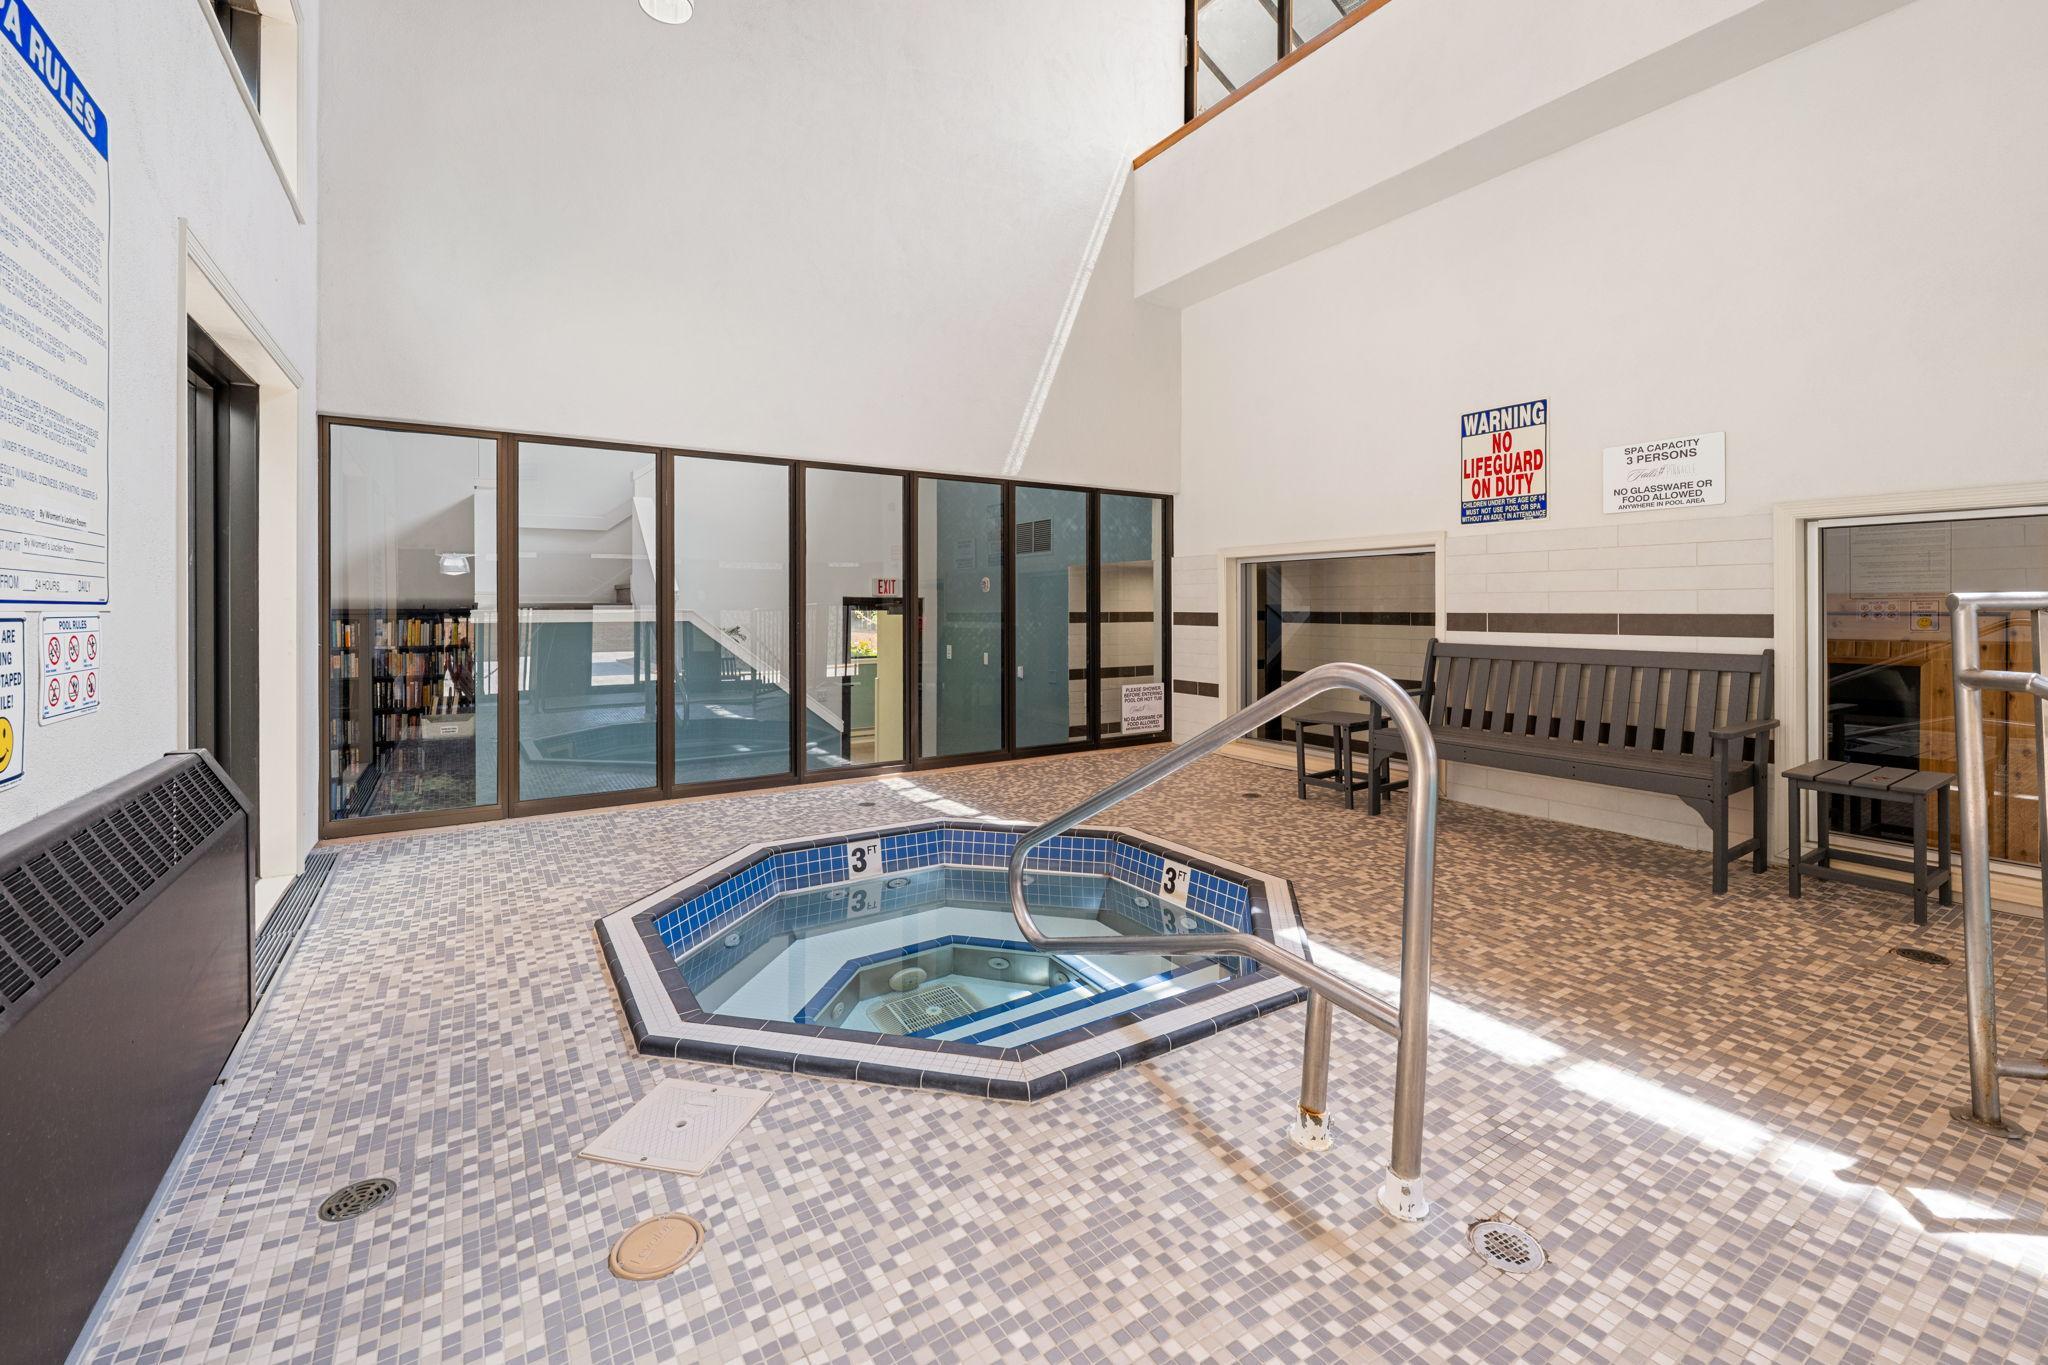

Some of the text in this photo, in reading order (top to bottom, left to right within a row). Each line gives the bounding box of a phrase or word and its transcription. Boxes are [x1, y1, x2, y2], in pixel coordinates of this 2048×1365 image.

[0, 0, 22, 46] A
[30, 24, 96, 138] RULES
[1464, 402, 1544, 436] WARNING
[1492, 432, 1512, 453] NO
[1625, 438, 1700, 455] SPA CAPACITY
[1464, 449, 1543, 479] LIFEGUARD
[1637, 448, 1697, 463] PERSONS
[1472, 472, 1533, 499] ON DUTY
[1614, 488, 1628, 496] NO
[1630, 481, 1693, 494] GLASSWARE
[1622, 489, 1702, 503] FOOD ALLOWED
[0, 574, 90, 592] FROM 24 HOURS DAILY
[878, 580, 896, 594] EXIT
[59, 620, 87, 630] POOL RULES
[1, 630, 15, 643] ARE
[1, 672, 21, 687] TAPED
[852, 845, 877, 872] 3 FT
[1164, 867, 1187, 894] 3 FT
